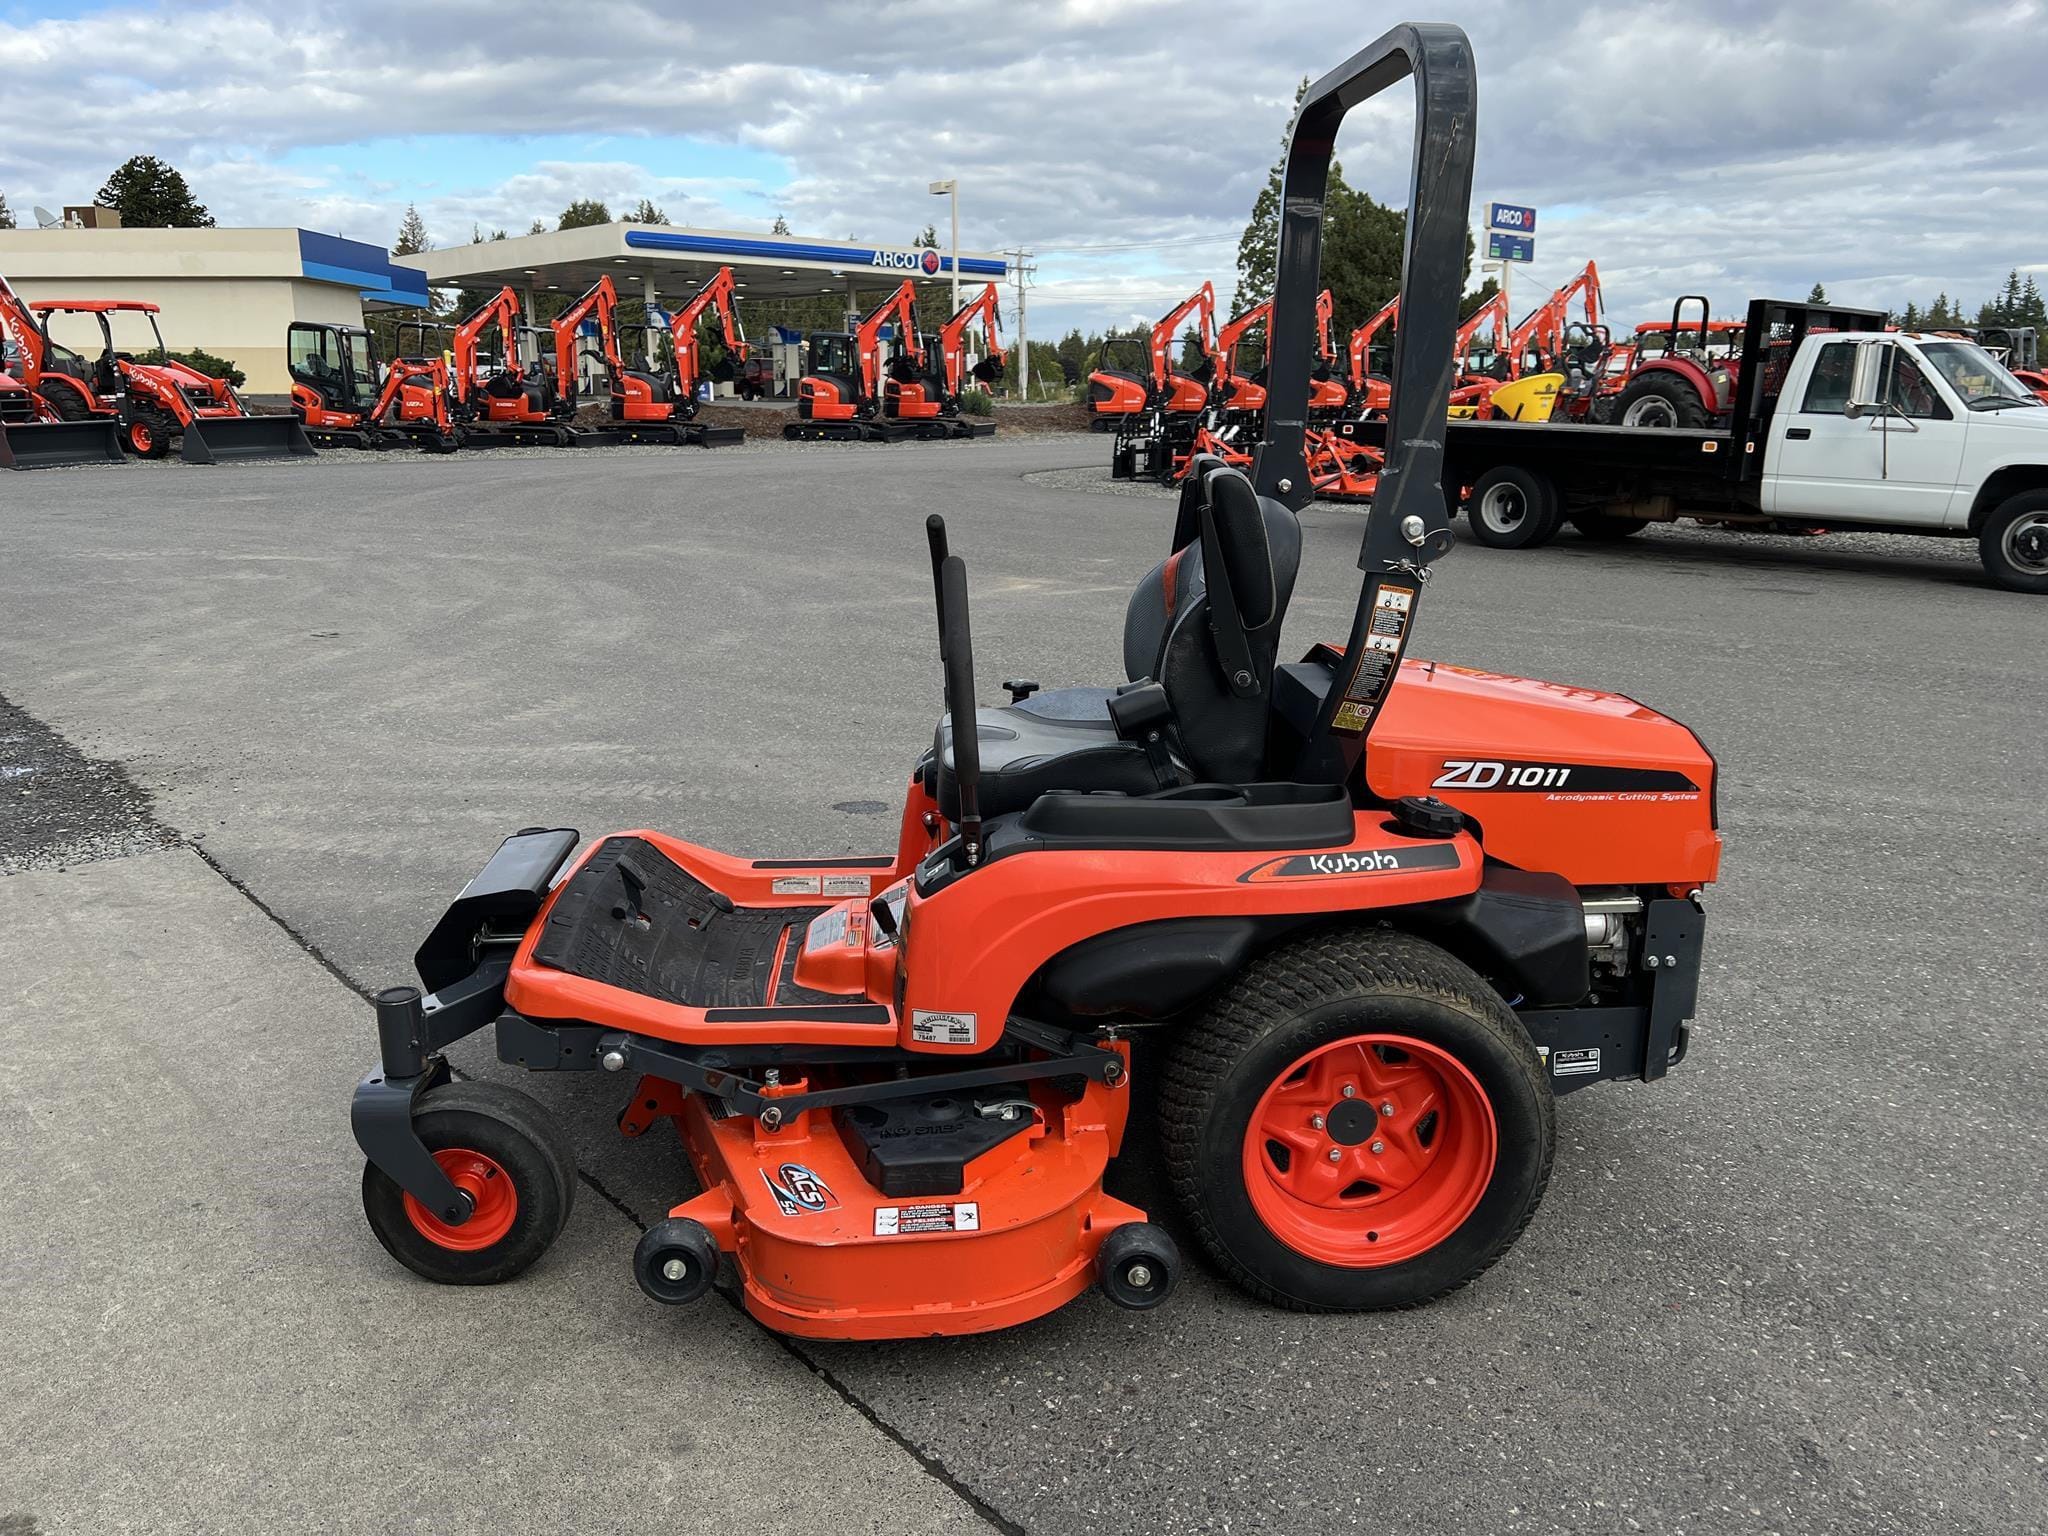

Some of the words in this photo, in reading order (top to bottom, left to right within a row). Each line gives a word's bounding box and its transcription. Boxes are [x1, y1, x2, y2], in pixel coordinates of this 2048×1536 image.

[1496, 208, 1522, 225] ARCO
[872, 250, 915, 269] ARCO
[9, 316, 35, 370] Kubota
[129, 367, 158, 390] Kubota
[1431, 761, 1505, 788] ZD
[1506, 767, 1571, 786] 1011
[1546, 793, 1614, 802] Aerodynamic
[1618, 793, 1658, 802] Cutting
[1660, 793, 1698, 801] System
[1310, 850, 1399, 874] Kubota
[787, 1169, 825, 1203] ACS
[780, 1200, 799, 1214] 54
